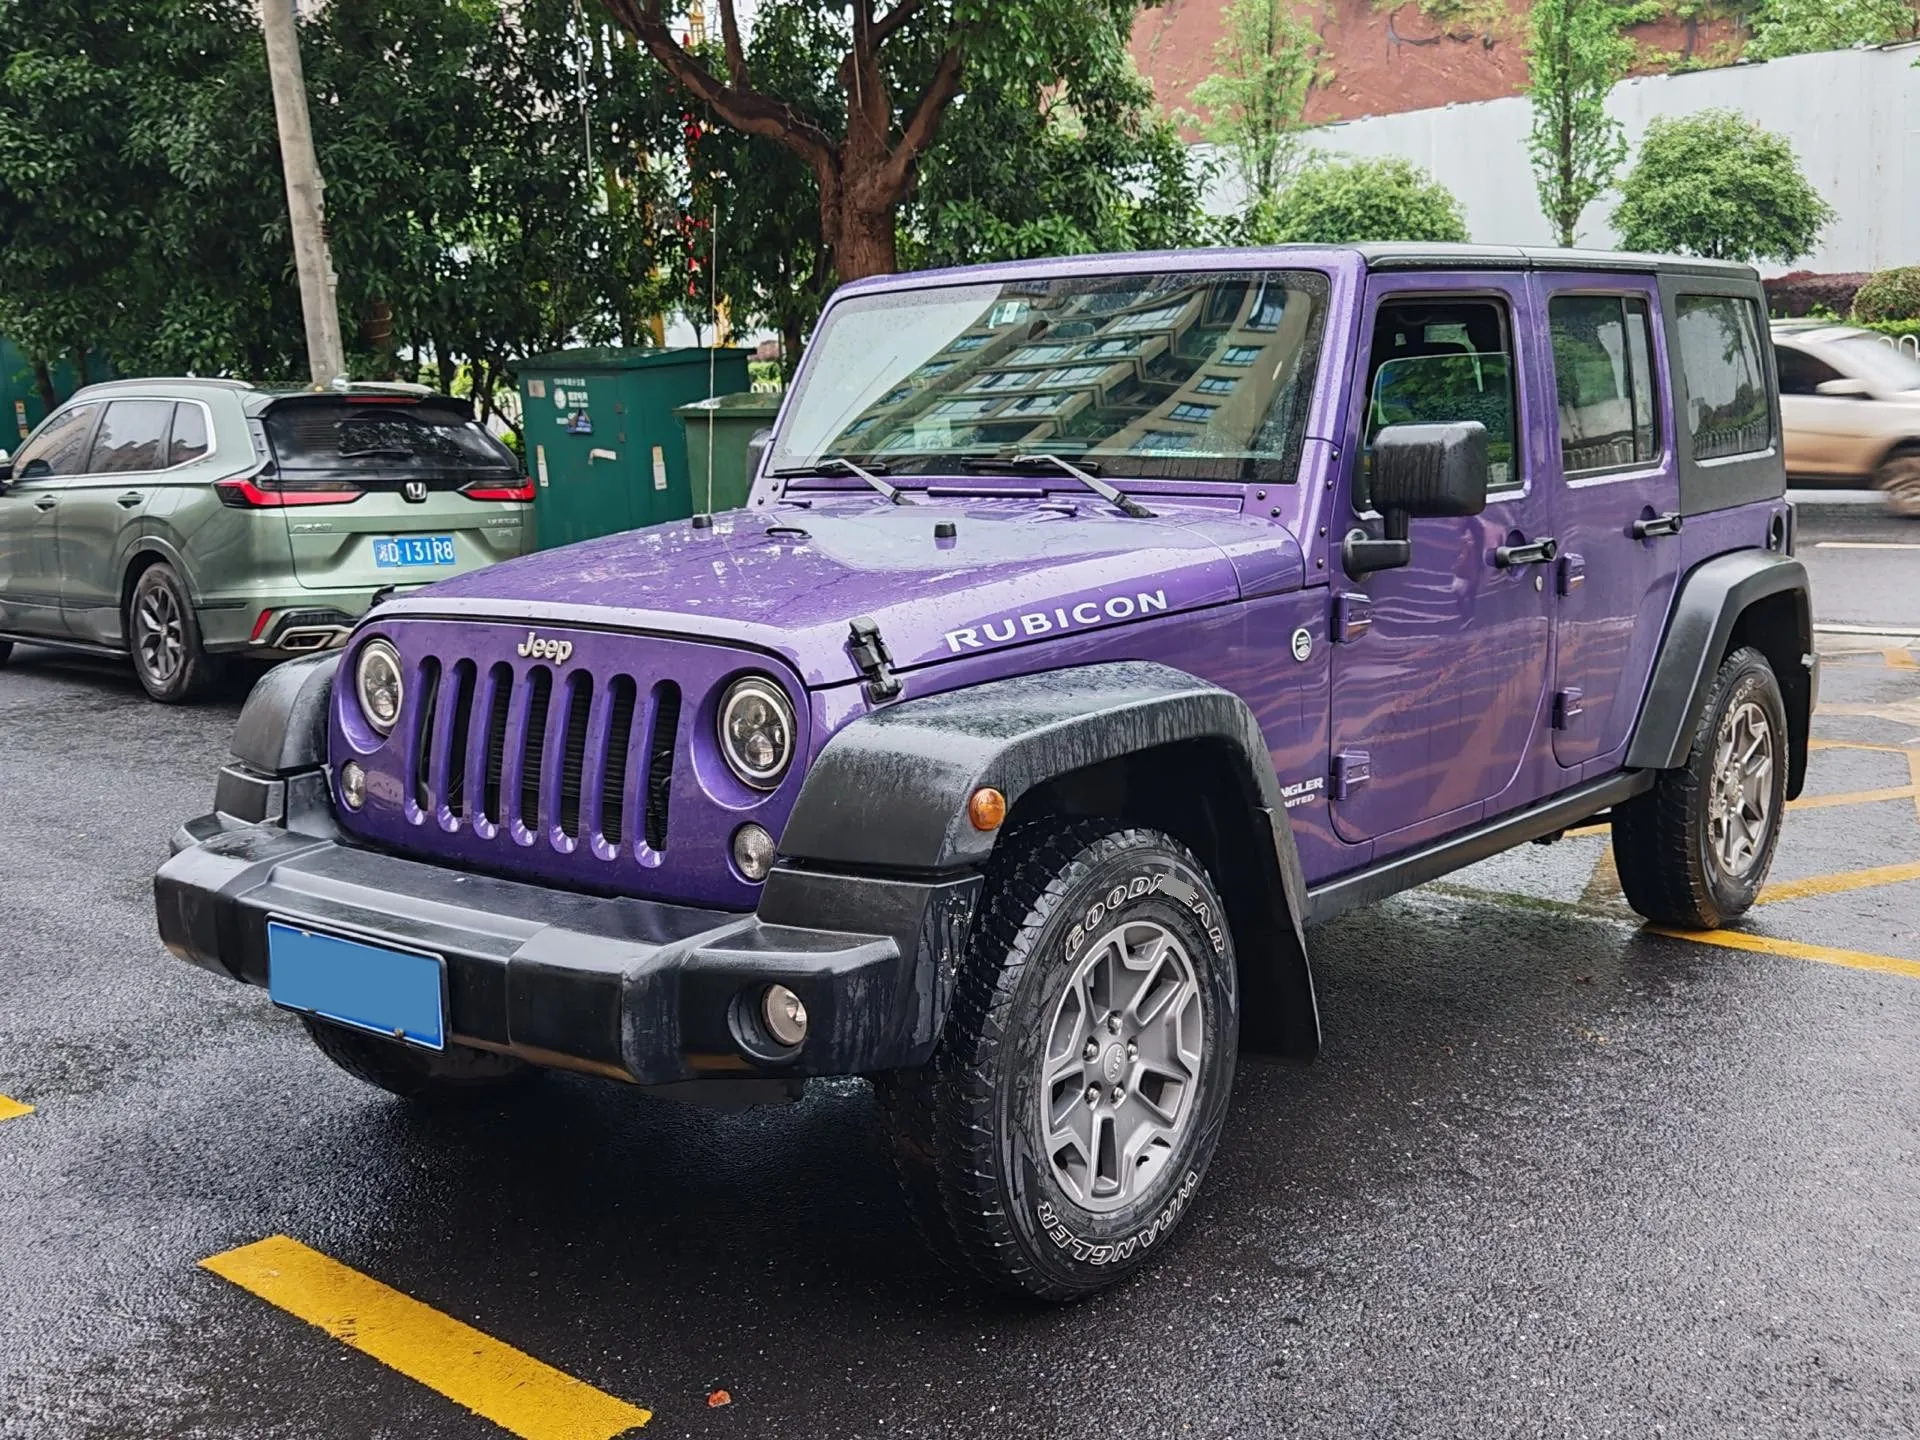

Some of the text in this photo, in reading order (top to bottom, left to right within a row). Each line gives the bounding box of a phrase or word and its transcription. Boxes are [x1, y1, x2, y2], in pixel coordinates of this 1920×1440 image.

[517, 631, 573, 665] Jeep
[944, 589, 1168, 652] RUBICON
[1280, 777, 1324, 798] NGLER
[1065, 873, 1225, 961] GOODAR
[1037, 1170, 1199, 1265] WRANGLER
